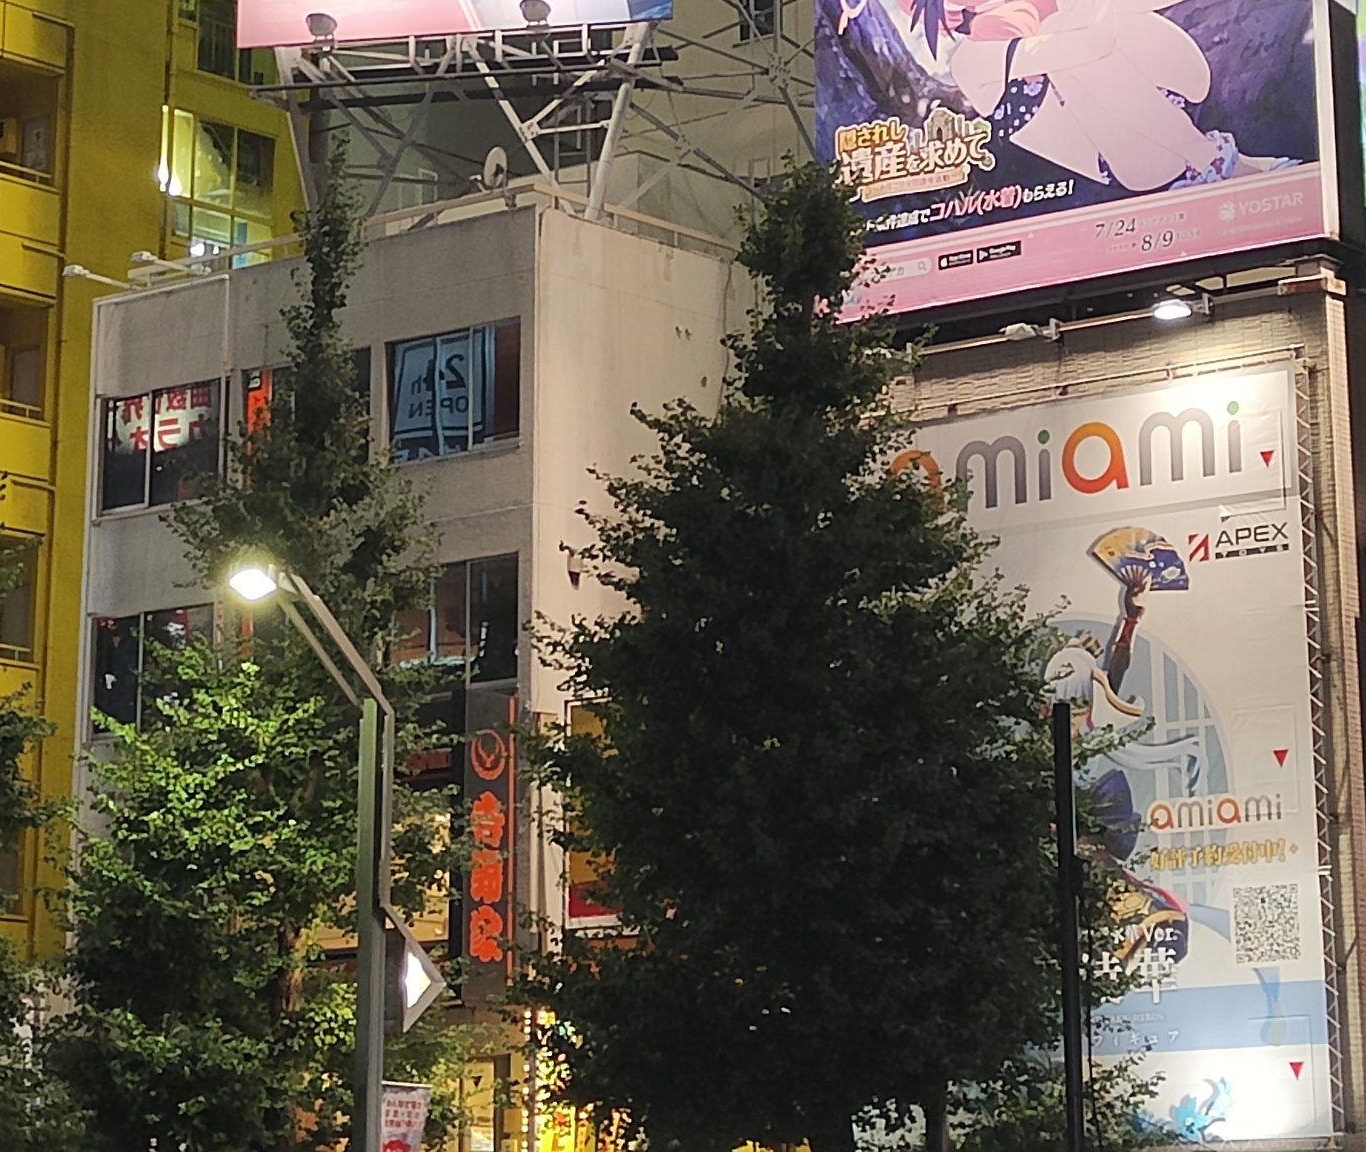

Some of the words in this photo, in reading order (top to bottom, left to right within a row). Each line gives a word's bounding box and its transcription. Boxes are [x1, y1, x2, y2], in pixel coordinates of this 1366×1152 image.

[1239, 192, 1304, 216] YOSTAR
[1095, 217, 1137, 239] 7/24
[1140, 230, 1174, 252] 8/9
[1215, 521, 1289, 548] APEX
[1149, 793, 1283, 831] amiami
